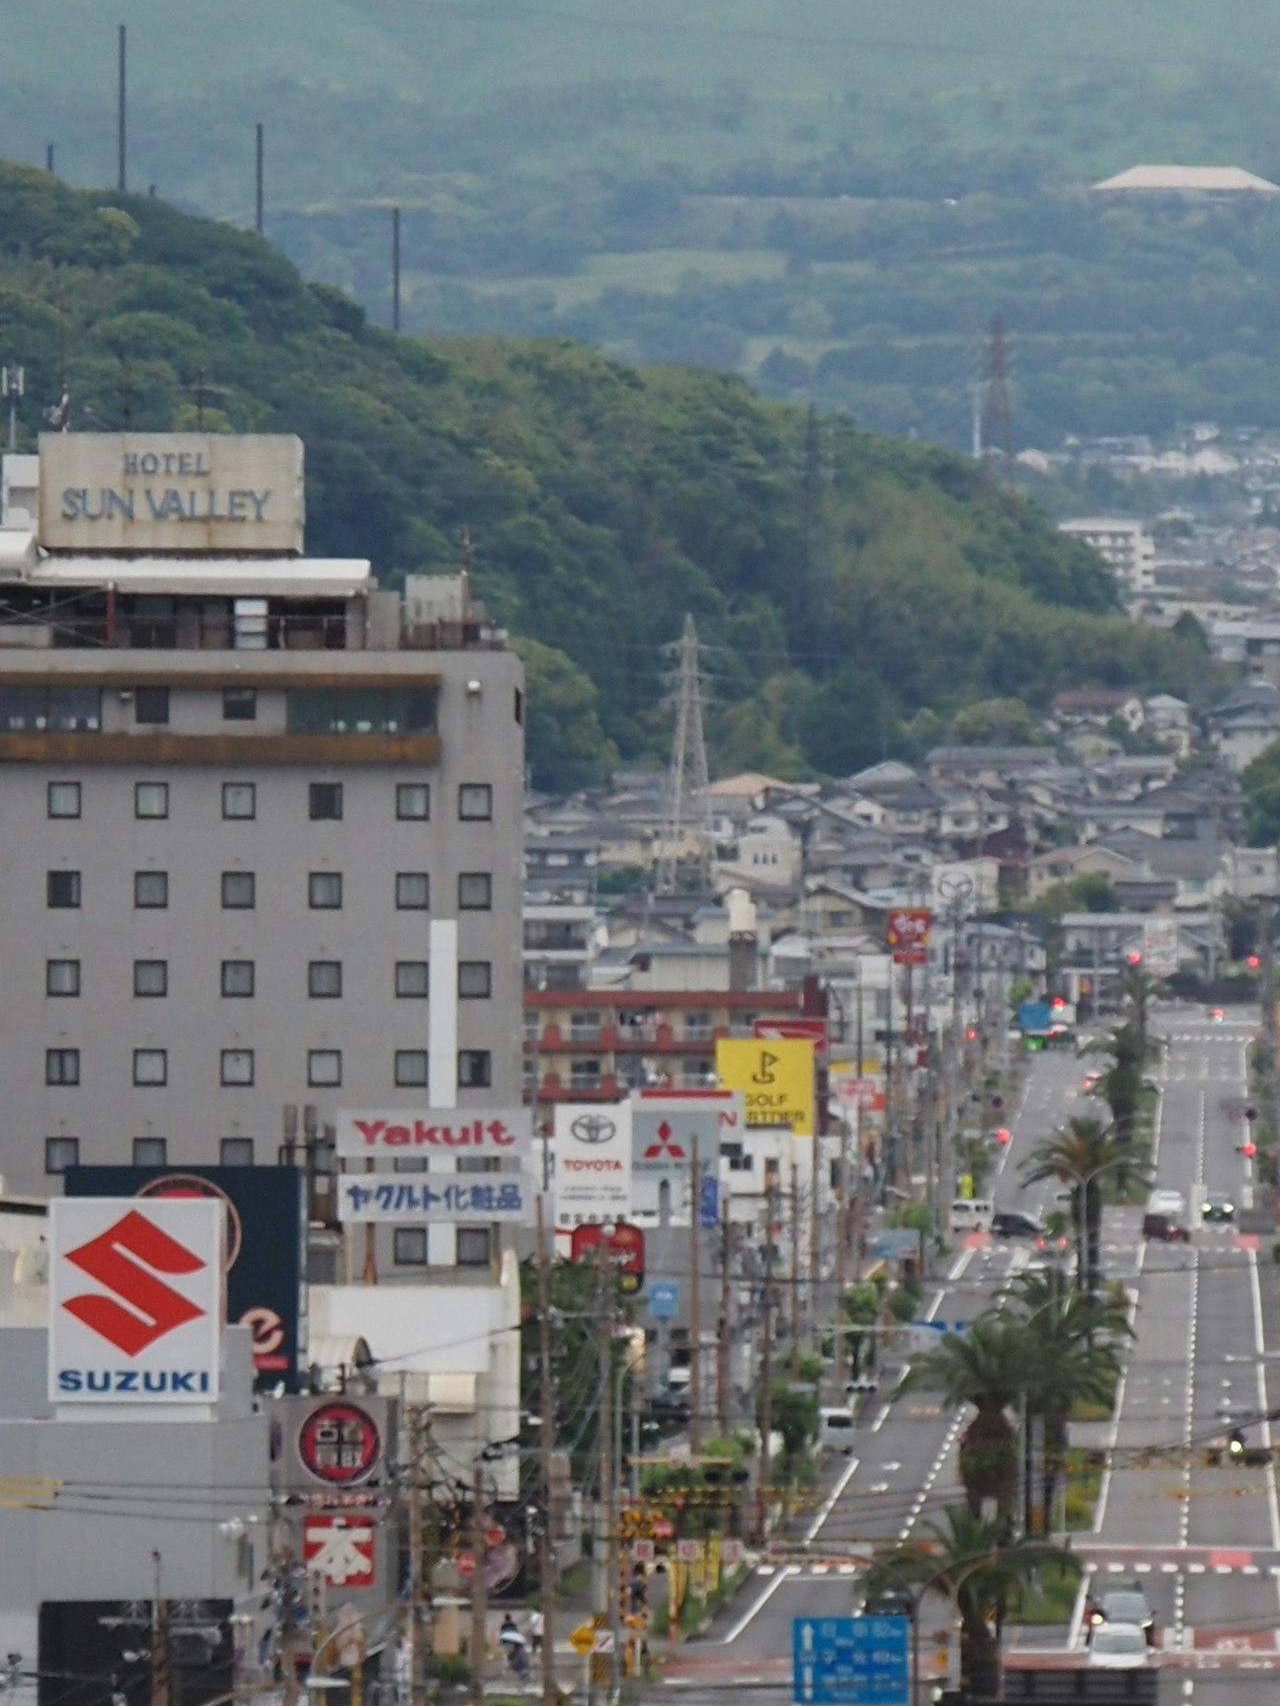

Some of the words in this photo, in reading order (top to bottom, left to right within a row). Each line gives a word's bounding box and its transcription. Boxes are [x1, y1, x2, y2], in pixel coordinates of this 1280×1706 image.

[123, 452, 211, 476] HOTEL
[62, 488, 134, 520] SUN
[145, 488, 271, 521] VALLEY
[355, 1119, 516, 1146] Yakult
[564, 1159, 623, 1172] TOYOTA
[347, 1184, 523, 1212] ヤクルト化粧品
[58, 1370, 209, 1392] SUZUKI
[306, 1517, 373, 1585] 本
